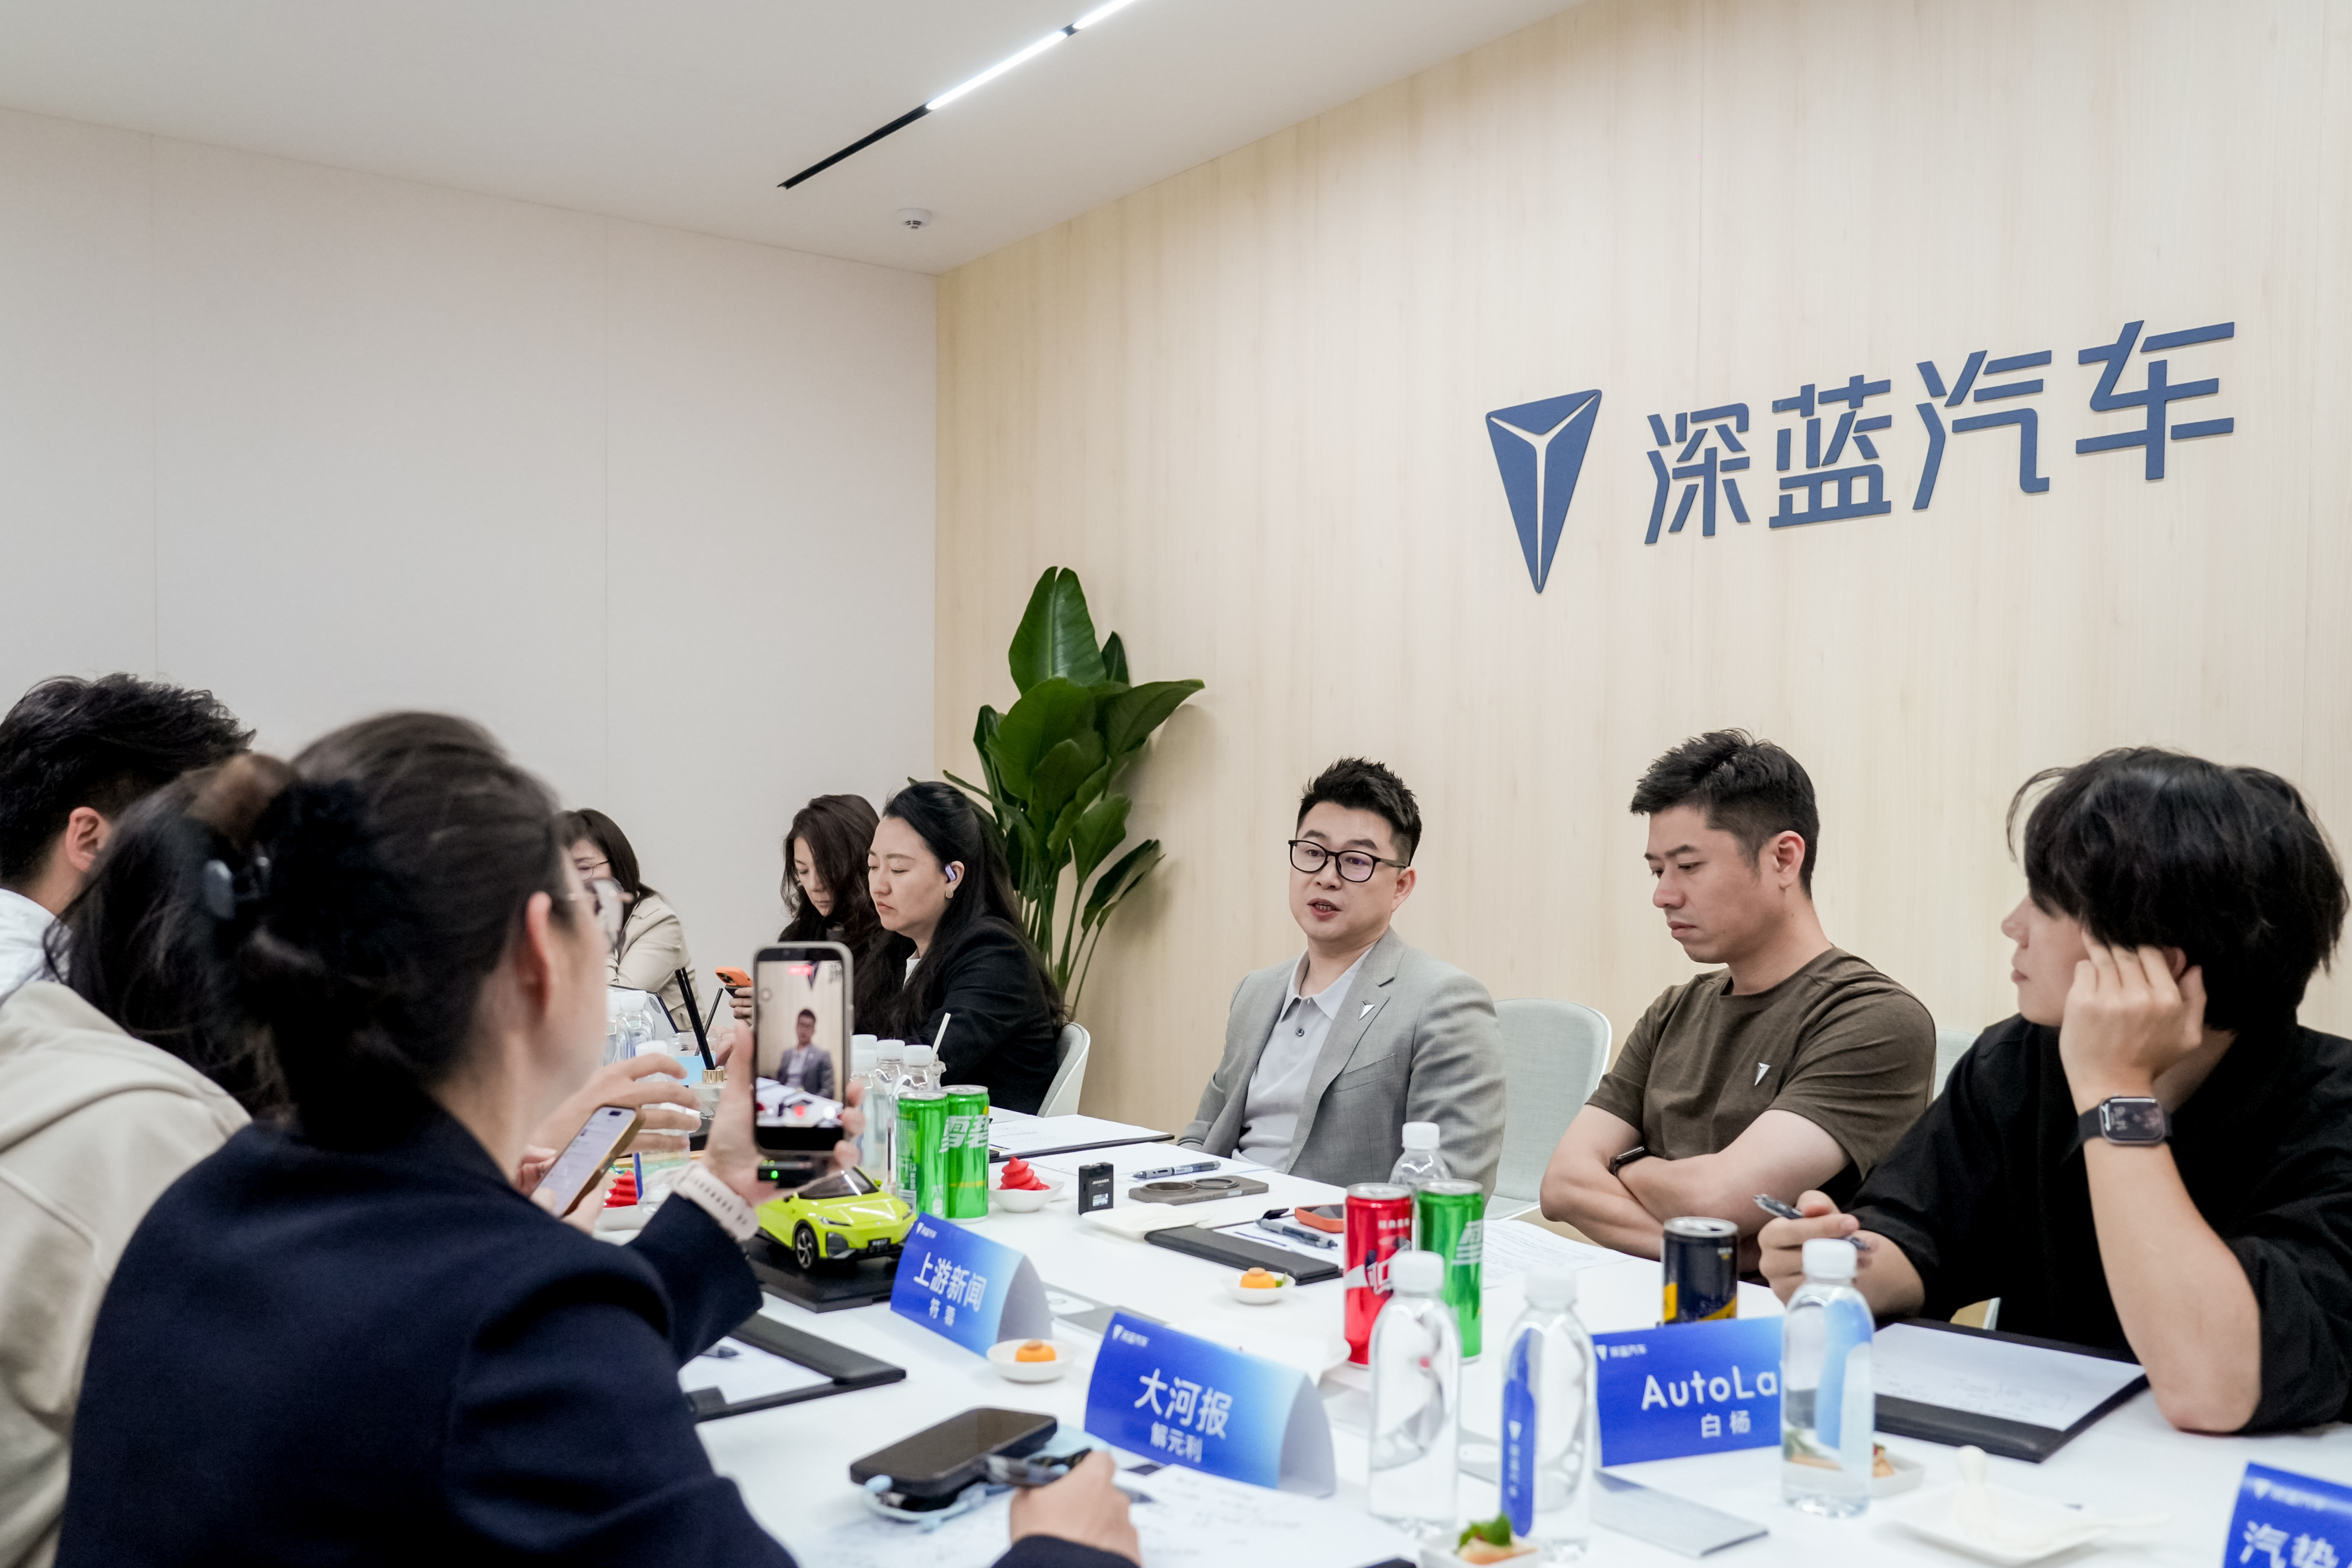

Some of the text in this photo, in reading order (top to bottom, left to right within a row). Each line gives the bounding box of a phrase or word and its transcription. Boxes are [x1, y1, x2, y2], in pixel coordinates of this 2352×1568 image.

[1645, 320, 2234, 545] 深蓝汽车
[938, 1114, 988, 1153] 雪碧
[913, 1251, 987, 1312] 上游新闻
[1134, 1367, 1234, 1440] 大河报
[1641, 1360, 1782, 1411] AutoLa
